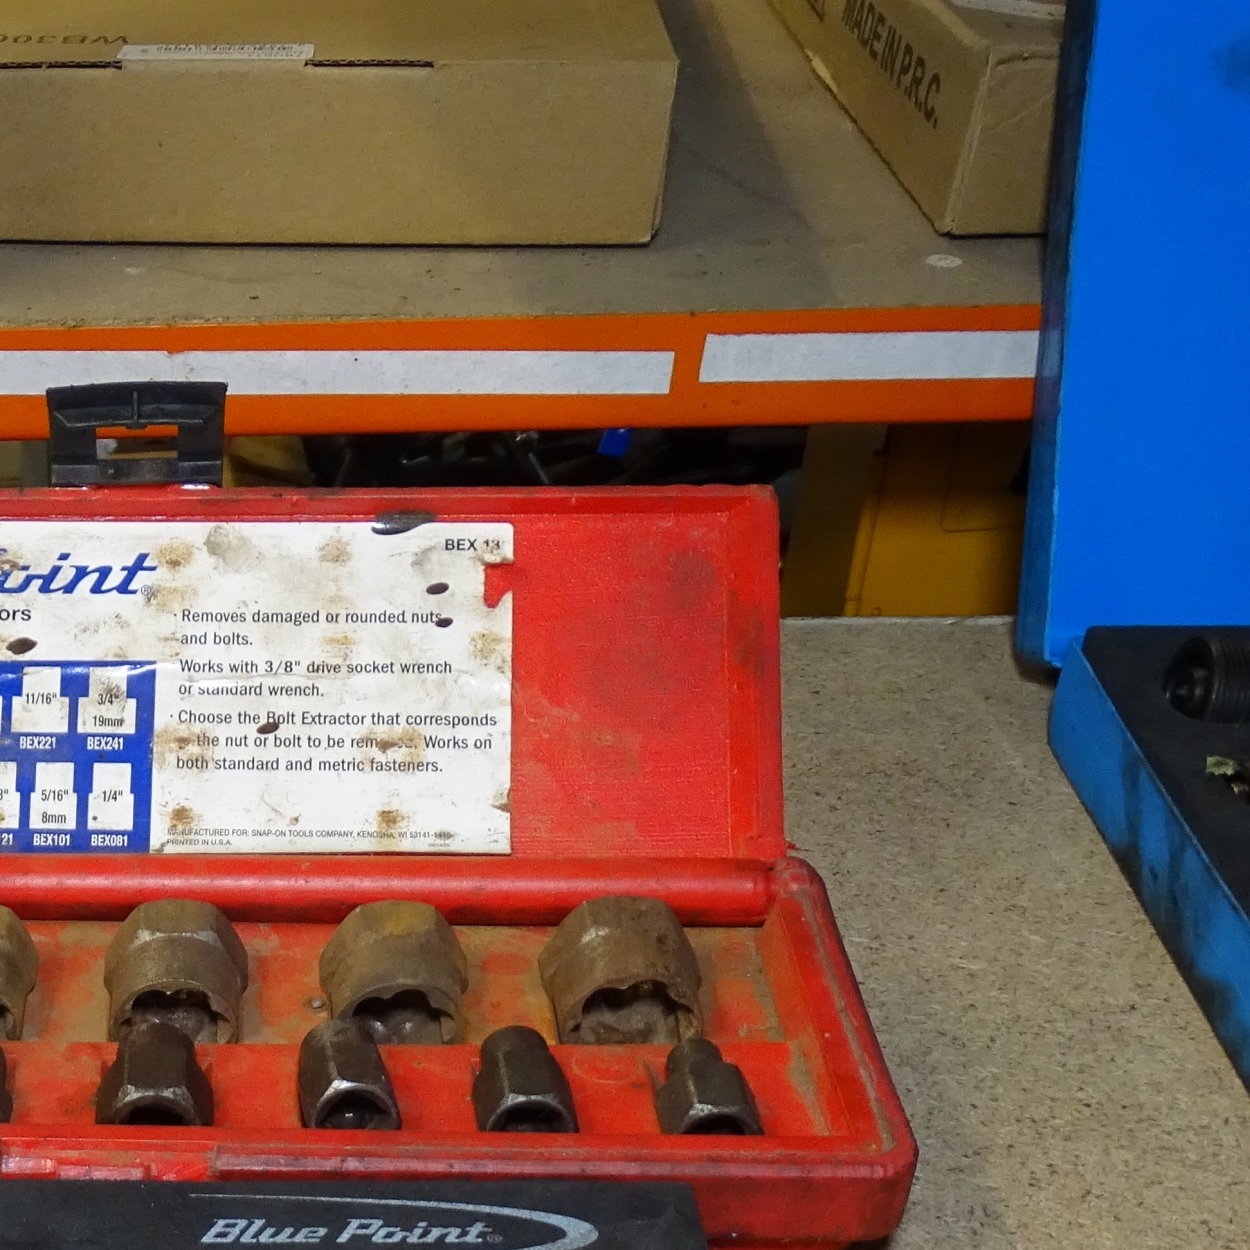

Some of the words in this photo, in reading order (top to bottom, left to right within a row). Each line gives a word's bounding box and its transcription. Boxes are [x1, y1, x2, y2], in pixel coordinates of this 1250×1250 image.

[880, 24, 903, 82] IN
[895, 42, 942, 130] P.R.C.
[444, 538, 478, 552] BEX
[181, 609, 247, 624] Removes
[252, 609, 320, 627] damaged
[325, 612, 341, 624] or
[345, 609, 407, 625] rounded
[180, 632, 207, 646] and
[213, 632, 253, 646] bolts.
[179, 659, 224, 674] Works
[229, 659, 259, 674] with
[264, 660, 301, 674] 3/8"
[306, 660, 342, 675] drive
[347, 660, 395, 675] socket
[400, 660, 452, 675] wrench
[178, 683, 193, 696] or
[267, 682, 324, 697] wrench.
[25, 693, 57, 704] 11/16"
[92, 715, 123, 728] 19mm
[178, 710, 232, 725] Choose
[237, 710, 261, 725] the
[266, 710, 296, 725] Bolt
[301, 711, 366, 726] Extractor
[371, 711, 400, 726] that
[405, 713, 497, 731] corresponds
[19, 736, 56, 749] BEX221
[87, 736, 124, 750] BEX241
[196, 733, 219, 747] the
[225, 734, 249, 748] nut
[254, 737, 269, 748] or
[273, 734, 302, 748] bolt
[307, 735, 322, 748] to
[327, 735, 345, 748] be
[423, 735, 469, 750] Works
[474, 738, 492, 750] on
[176, 756, 209, 771] both
[214, 757, 280, 772] standard
[285, 757, 313, 772] and
[318, 757, 365, 772] metric
[370, 757, 443, 773] fasteners.
[41, 789, 69, 801] 5/16"
[102, 790, 124, 802] 1/4"
[41, 811, 66, 824] 8mm
[33, 833, 70, 846] BEX101
[91, 834, 128, 847] BEX081
[232, 828, 250, 837] FOR:
[251, 829, 287, 838] SNAP-ON
[289, 829, 314, 838] TOOLS
[315, 830, 355, 839] COMPANY,
[398, 831, 408, 839] WI
[166, 838, 200, 846] PRINTED
[201, 838, 209, 846] IN
[200, 1218, 328, 1245] Blue
[336, 1218, 492, 1245] Point
